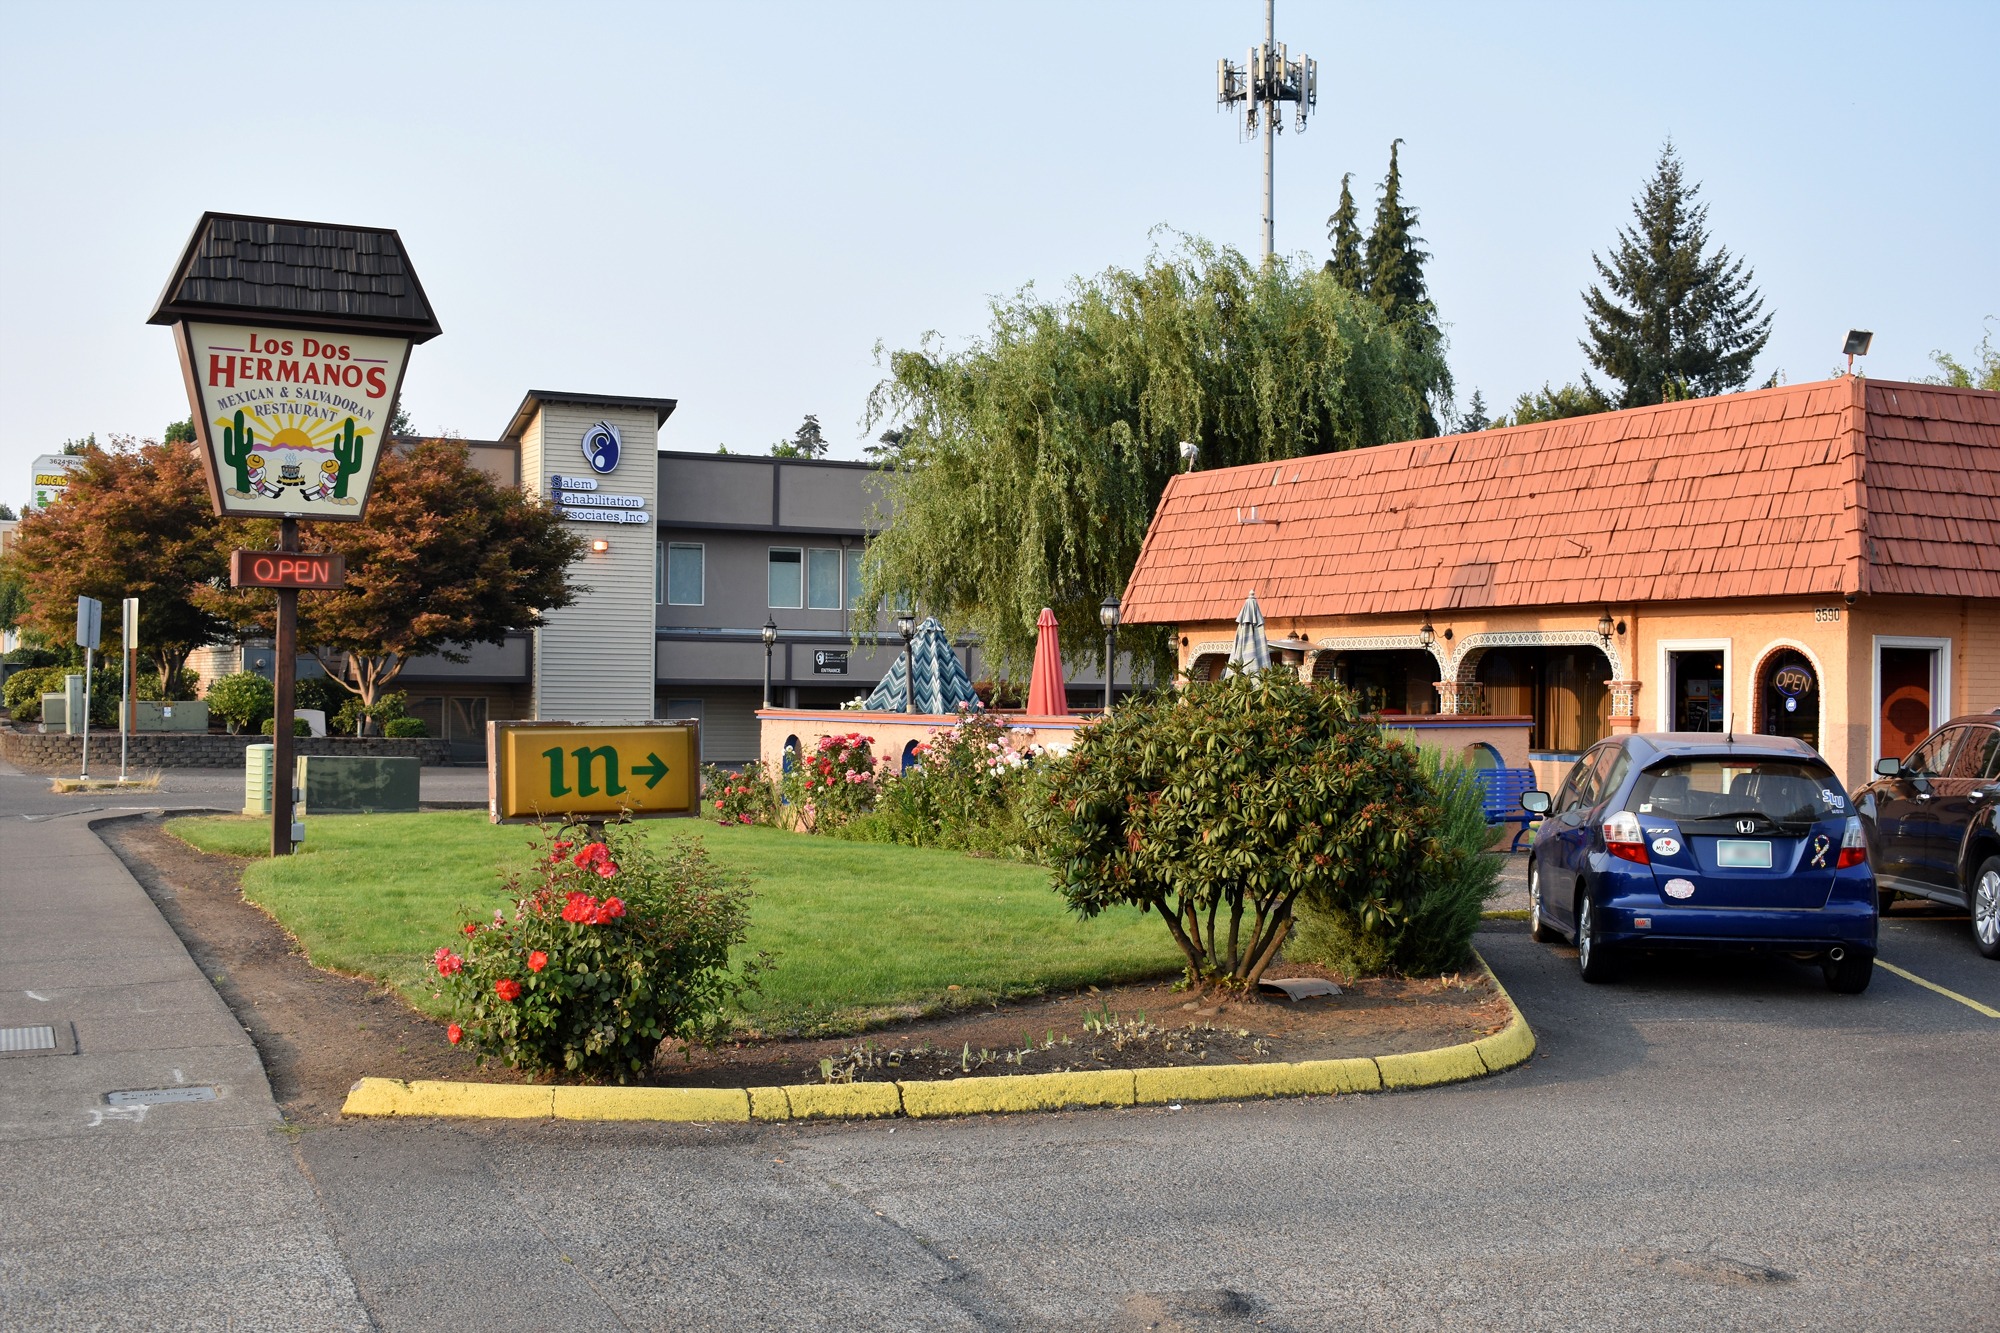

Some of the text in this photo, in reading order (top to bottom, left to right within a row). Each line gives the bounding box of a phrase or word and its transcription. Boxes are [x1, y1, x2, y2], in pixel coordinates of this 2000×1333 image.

[249, 333, 351, 361] Los Dos
[208, 354, 387, 399] HERMANOS
[217, 386, 375, 421] MEXICAN & SALVADORAN
[254, 402, 339, 423] RESTAURANT
[35, 474, 68, 486] BRICKS
[551, 475, 592, 489] Salem
[551, 490, 639, 506] Rehabilitation
[624, 511, 646, 523] Inc.
[254, 557, 330, 583] OPEN
[1816, 608, 1839, 621] 3590
[1776, 671, 1812, 692] OPEN
[542, 745, 627, 798] in
[1821, 788, 1845, 809] SLU
